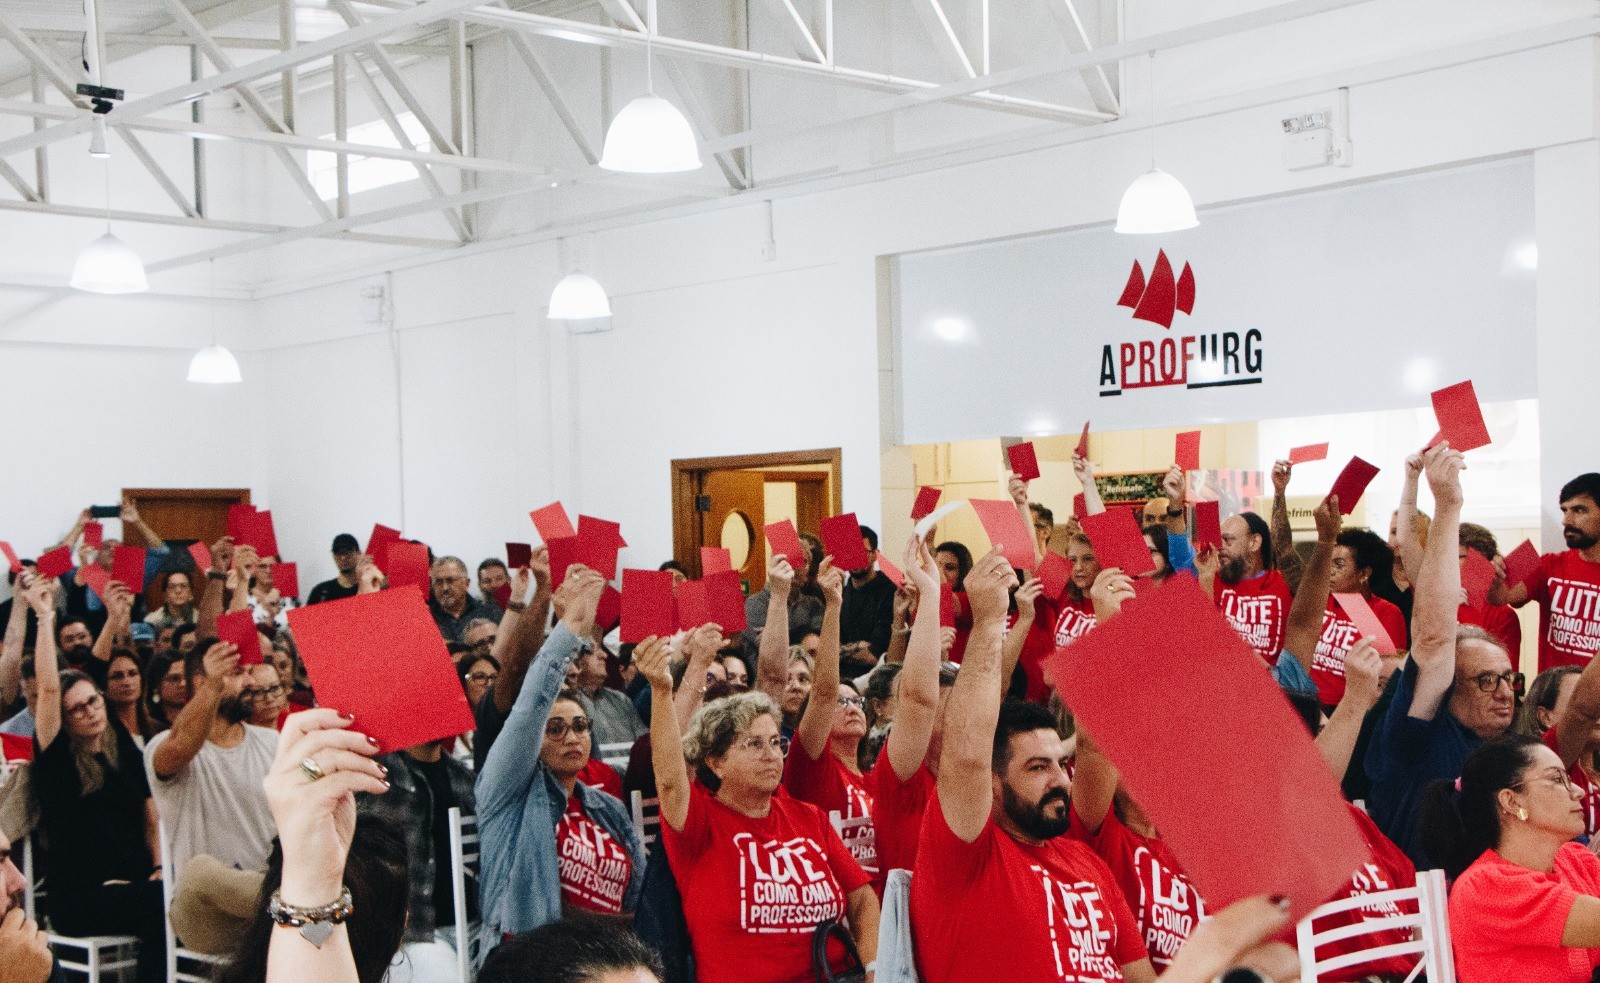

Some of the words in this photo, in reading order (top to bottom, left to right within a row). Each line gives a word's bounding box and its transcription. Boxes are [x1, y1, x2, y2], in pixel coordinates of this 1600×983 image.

[1099, 328, 1262, 388] APROFURG
[1225, 595, 1273, 626] LUTE
[748, 841, 826, 886] LUTE
[753, 881, 800, 905] COMO
[801, 879, 836, 905] UMA
[751, 901, 838, 925] PROFESSORA
[1151, 903, 1193, 939] COMO
